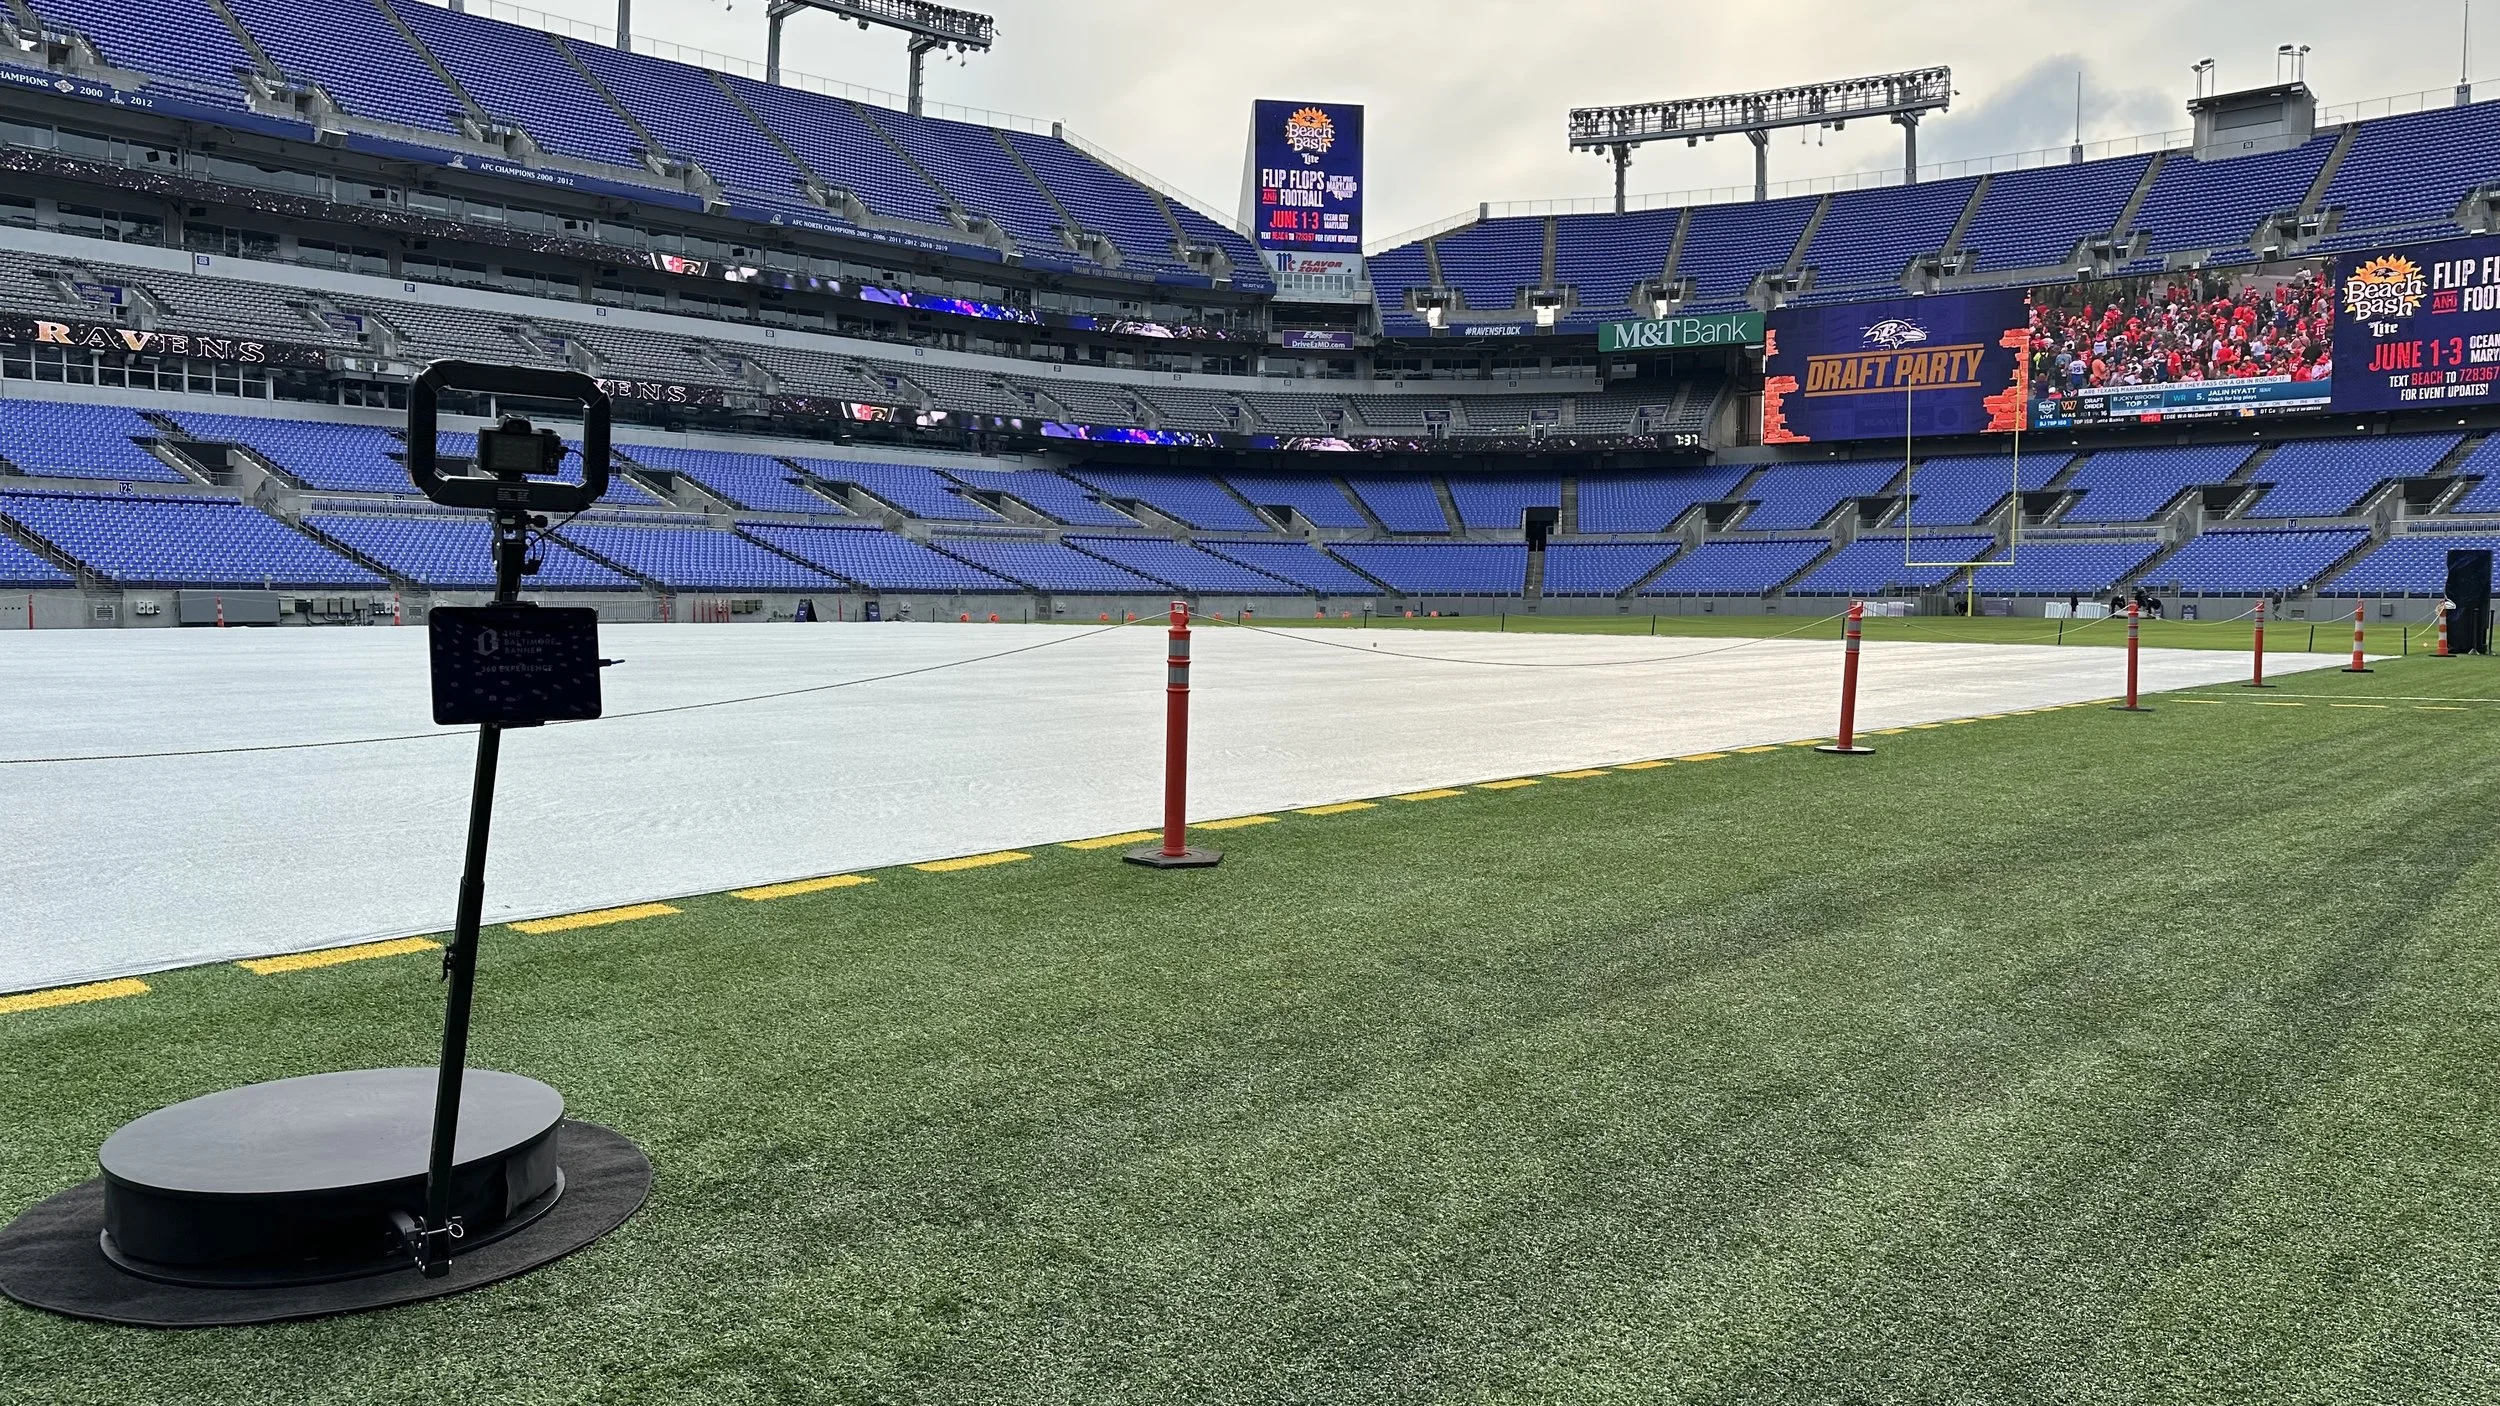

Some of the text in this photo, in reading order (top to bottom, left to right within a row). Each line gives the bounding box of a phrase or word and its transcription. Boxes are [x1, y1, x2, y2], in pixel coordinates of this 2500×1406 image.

[80, 86, 103, 97] 2000
[130, 96, 153, 107] 2012
[1289, 121, 1332, 138] Beach
[1294, 137, 1327, 152] Bash
[1301, 153, 1319, 164] Lite
[480, 163, 574, 186] AFC CHAMPIONS 2000 2012
[1262, 169, 1325, 190] FLIP FLOPS
[1326, 181, 1357, 193] MARYLAND
[1280, 189, 1324, 207] FOOTBALL
[1270, 210, 1319, 230] JUNE 1-3
[1324, 213, 1350, 222] OCEAN CITY
[804, 220, 823, 230] NORTH
[824, 225, 856, 235] CHAMPIONS
[1324, 222, 1348, 230] MARYLAND
[1315, 234, 1323, 242] FOR
[1324, 234, 1337, 242] EVENT
[1338, 235, 1358, 243] UPDATES!
[1301, 260, 1343, 268] FLAVOR
[1073, 266, 1090, 275] THANK
[1092, 268, 1103, 276] YOU
[1103, 269, 1132, 279] FRONTLINE
[2433, 259, 2475, 289] FLIP
[2347, 273, 2422, 303] Beach
[2355, 296, 2412, 321] Bash
[2433, 295, 2457, 309] AND
[1465, 326, 1521, 336] #RAVENSFLOCK
[1614, 316, 1747, 349] M&T Bank
[2315, 326, 2326, 336] 15
[2368, 321, 2398, 337] Lite
[34, 320, 265, 363] RAVENS
[1292, 340, 1346, 348] DriveEzMD.com
[2469, 333, 2500, 349] OCEAN
[2369, 337, 2463, 372] JUNE 1-3
[1805, 349, 1986, 392] DRAFT PARTY
[2289, 362, 2298, 372] 15
[2389, 366, 2500, 387] TEXT BEACH TO 728367
[2173, 394, 2186, 402] WR
[2196, 393, 2205, 401] 5.
[2208, 388, 2230, 396] JALIN
[2231, 387, 2257, 395] HYATT
[2401, 383, 2489, 401] FOR EVENT UPDATES!
[1675, 434, 1698, 446] 7:37
[120, 483, 133, 493] 125
[504, 638, 555, 646] BALTIMORE
[481, 664, 553, 673] 360 EXPERIENCE
